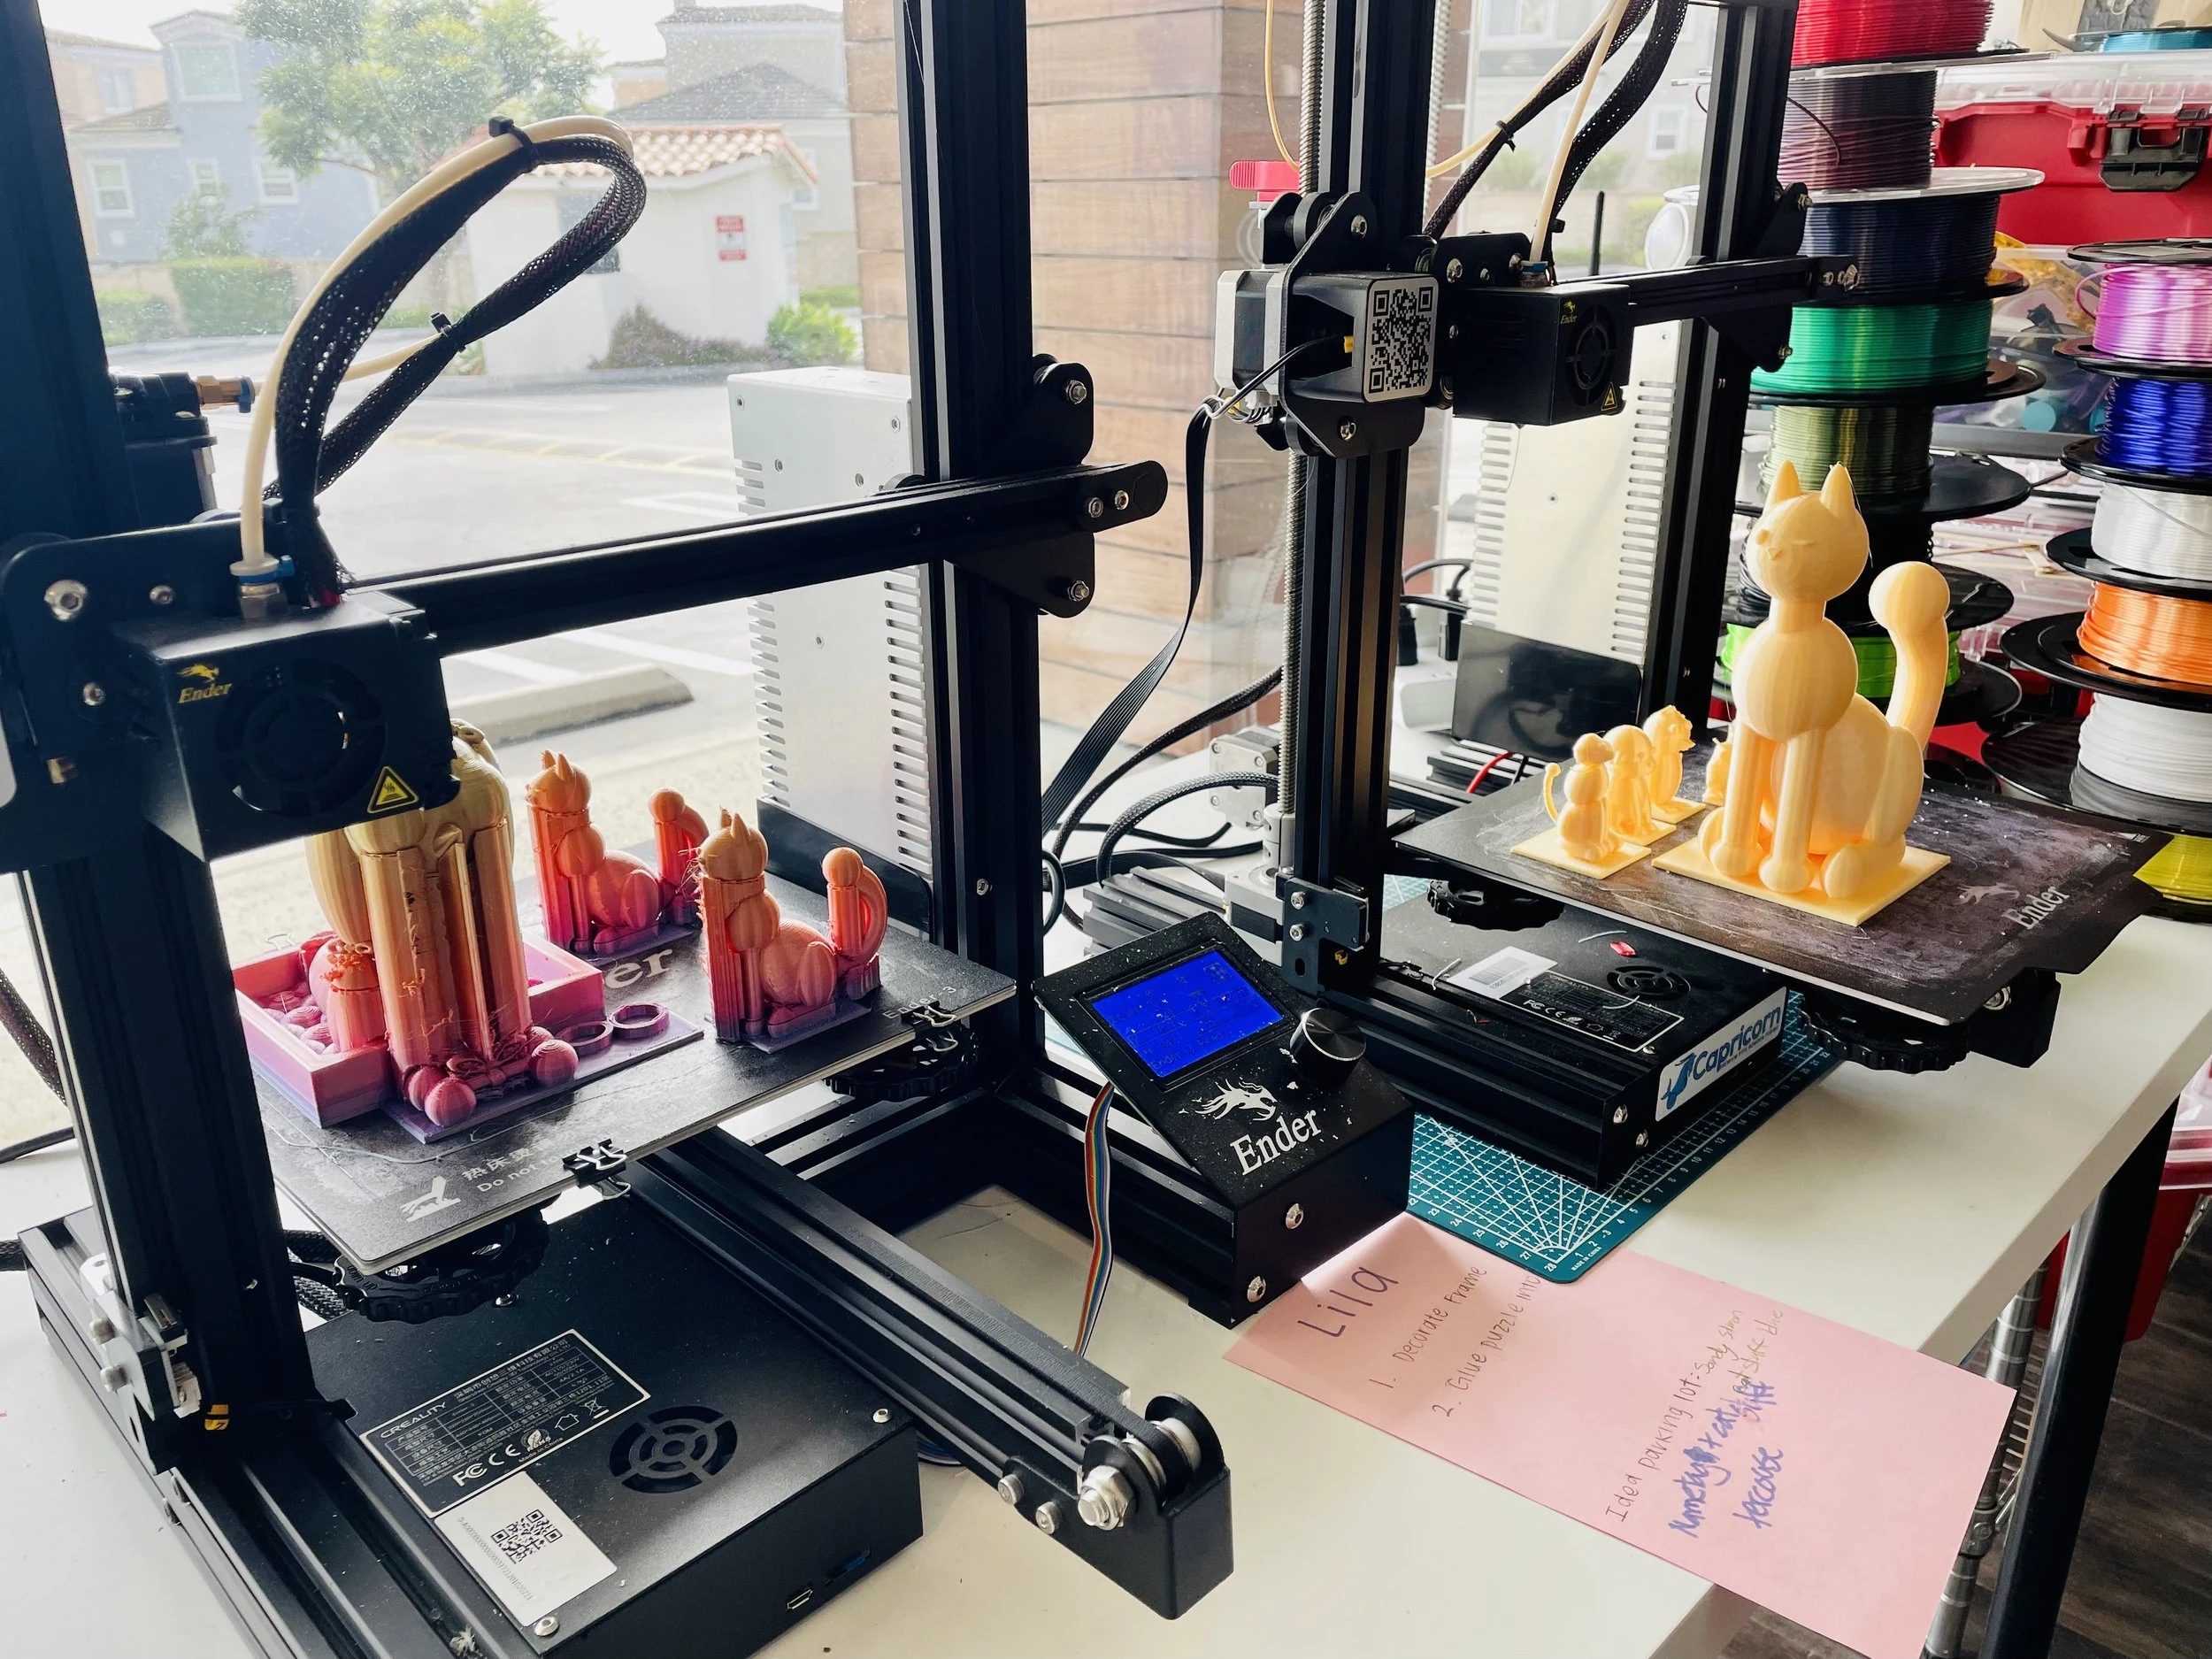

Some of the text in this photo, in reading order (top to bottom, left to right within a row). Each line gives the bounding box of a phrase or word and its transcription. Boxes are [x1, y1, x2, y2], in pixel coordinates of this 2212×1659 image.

[178, 683, 233, 703] Ender
[2001, 886, 2070, 931] Ender
[1693, 1007, 1781, 1081] Capricorn
[1230, 1110, 1322, 1176] Ender
[1691, 1156, 1701, 1164] 10
[477, 1177, 505, 1193] Do
[508, 1164, 537, 1181] not
[1428, 1209, 1440, 1217] 23
[1472, 1229, 1486, 1239] 25
[1496, 1240, 1509, 1249] 26
[1519, 1251, 1532, 1261] 27
[1544, 1263, 1557, 1272] 28
[1571, 1259, 1586, 1271] MADE
[1588, 1246, 1603, 1258] CHINA
[1297, 1266, 1399, 1338] Lila
[1369, 1266, 1487, 1389] 1. Decorate Frame
[1480, 1302, 1524, 1351] puzzle
[1446, 1351, 1487, 1390] Glue
[378, 1400, 450, 1440] CREALITY
[1432, 1401, 1463, 1417] 2.
[542, 1435, 565, 1449] China
[1605, 1474, 1643, 1523] Idea
[1638, 1406, 1694, 1471] parking
[1673, 1371, 1701, 1402] lot:
